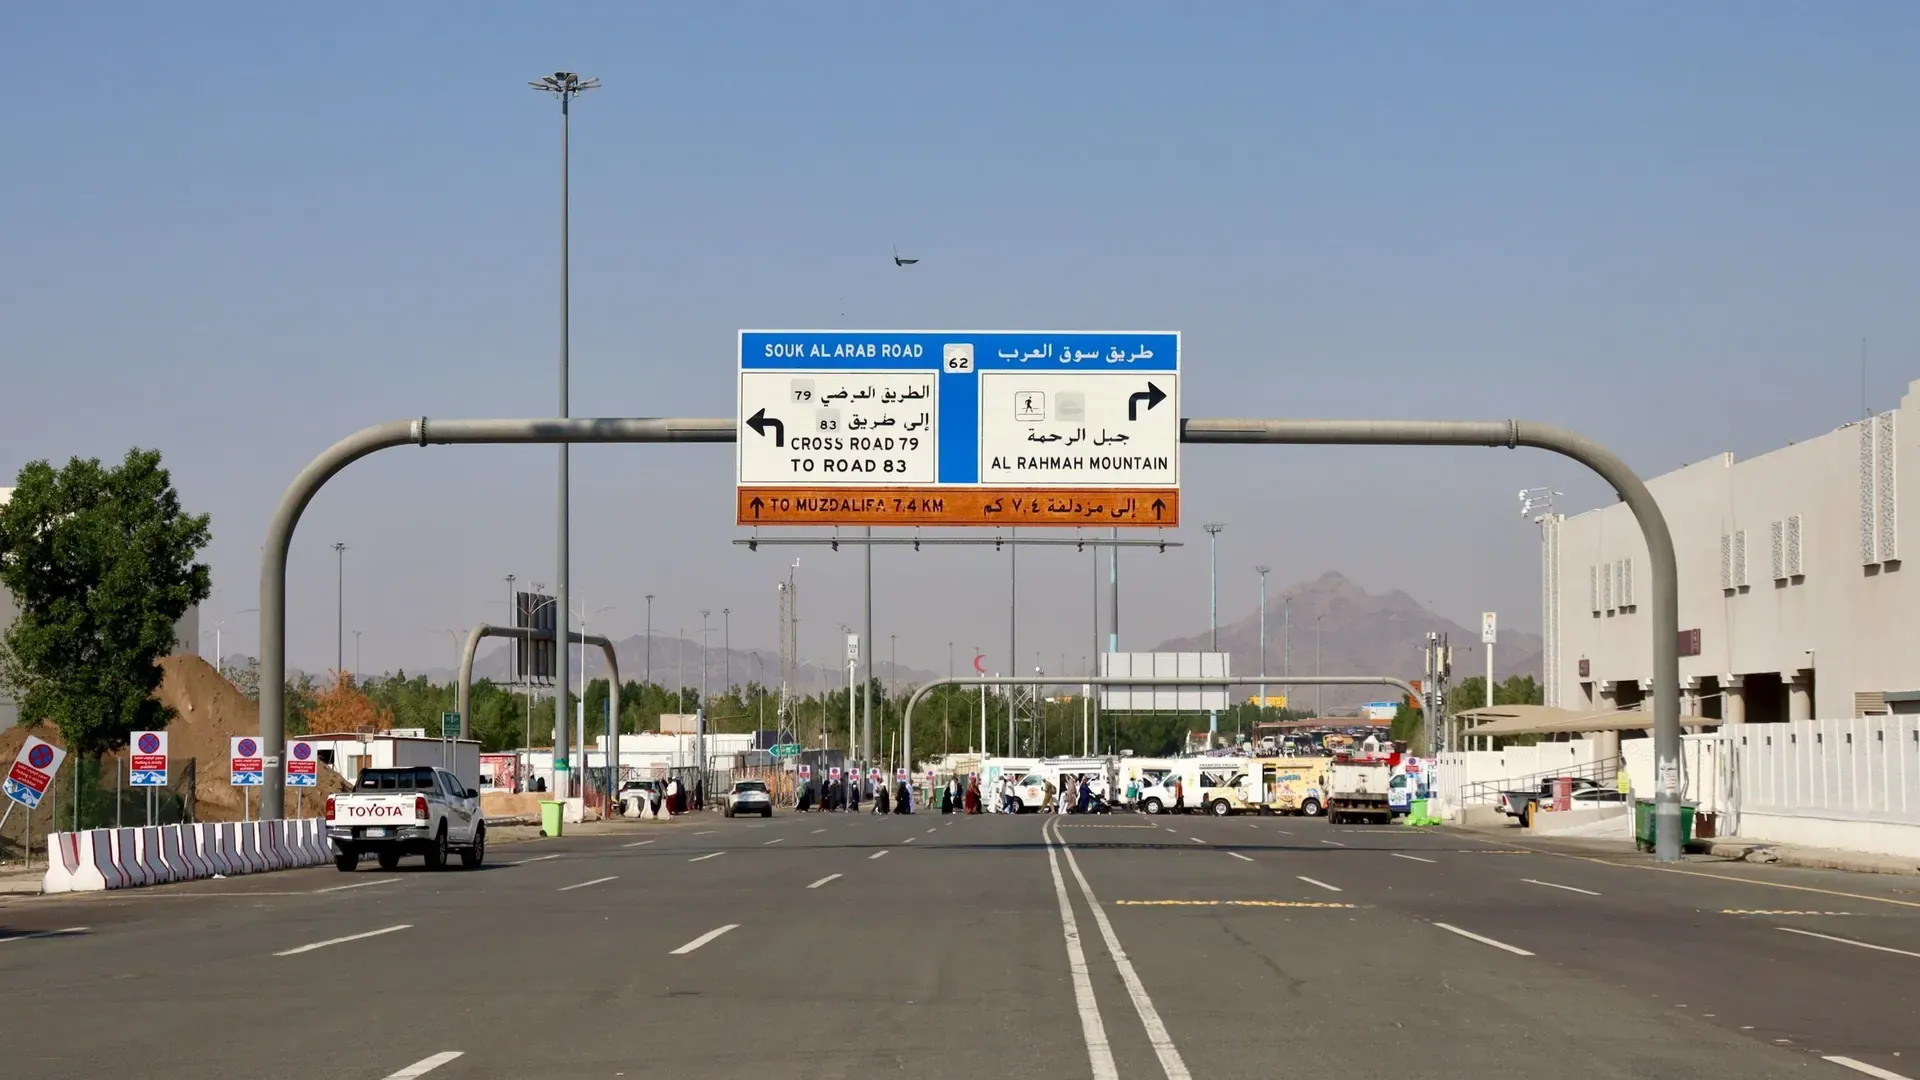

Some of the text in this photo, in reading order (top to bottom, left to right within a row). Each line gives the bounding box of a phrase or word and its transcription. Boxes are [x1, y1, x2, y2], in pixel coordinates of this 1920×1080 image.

[764, 343, 923, 358] SOUK AL ARAB ROAD
[997, 343, 1154, 364] طريق سوق العرب
[948, 357, 969, 369] 62
[795, 390, 812, 401] 79
[880, 384, 930, 404] الطريق
[820, 412, 929, 432] إلى طريق 83
[791, 437, 919, 451] CROSS ROAD 79
[1027, 427, 1130, 447] جبل الرحمة
[790, 458, 907, 473] TO ROAD 83
[991, 456, 1168, 470] AL RAHMAH MOUNTAIN
[770, 498, 943, 512] TO MUZDALIFA 7.4 KM
[983, 497, 1004, 517] كم
[1047, 499, 1104, 517] مزدلفة
[1110, 498, 1136, 519] إلى
[348, 806, 403, 817] TOYOTA
